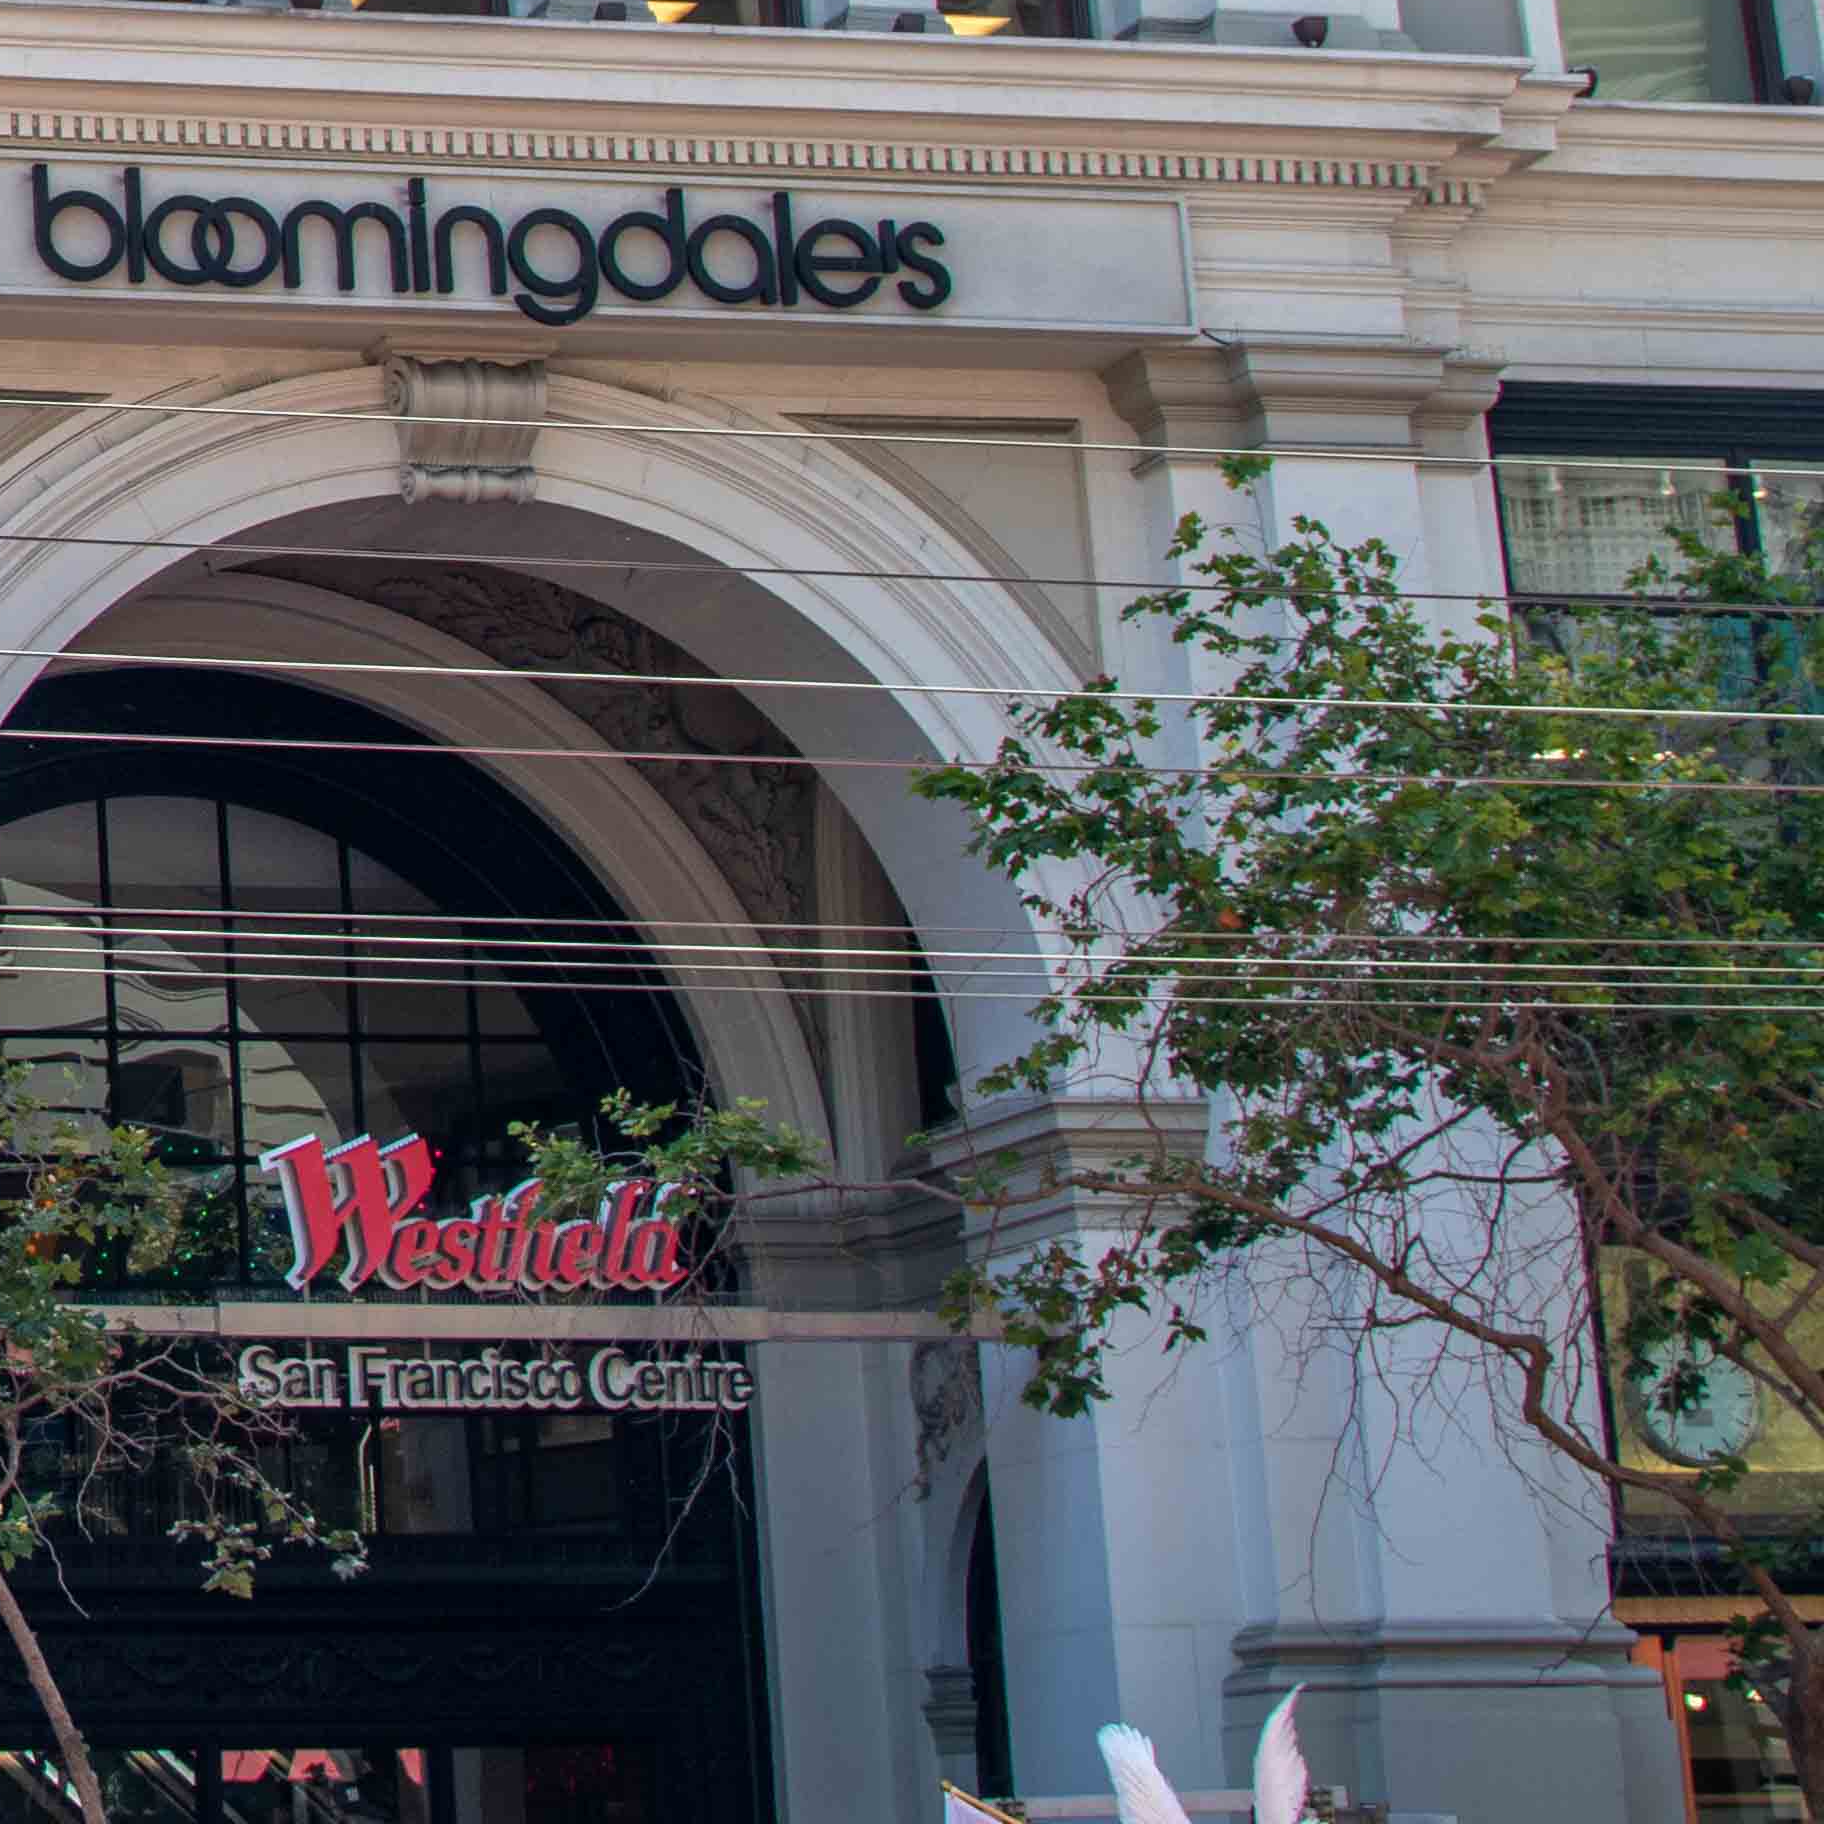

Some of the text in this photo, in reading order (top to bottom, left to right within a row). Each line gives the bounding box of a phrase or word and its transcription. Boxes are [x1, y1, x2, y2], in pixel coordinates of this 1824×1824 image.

[238, 1344, 754, 1410] San Francisco Centre
